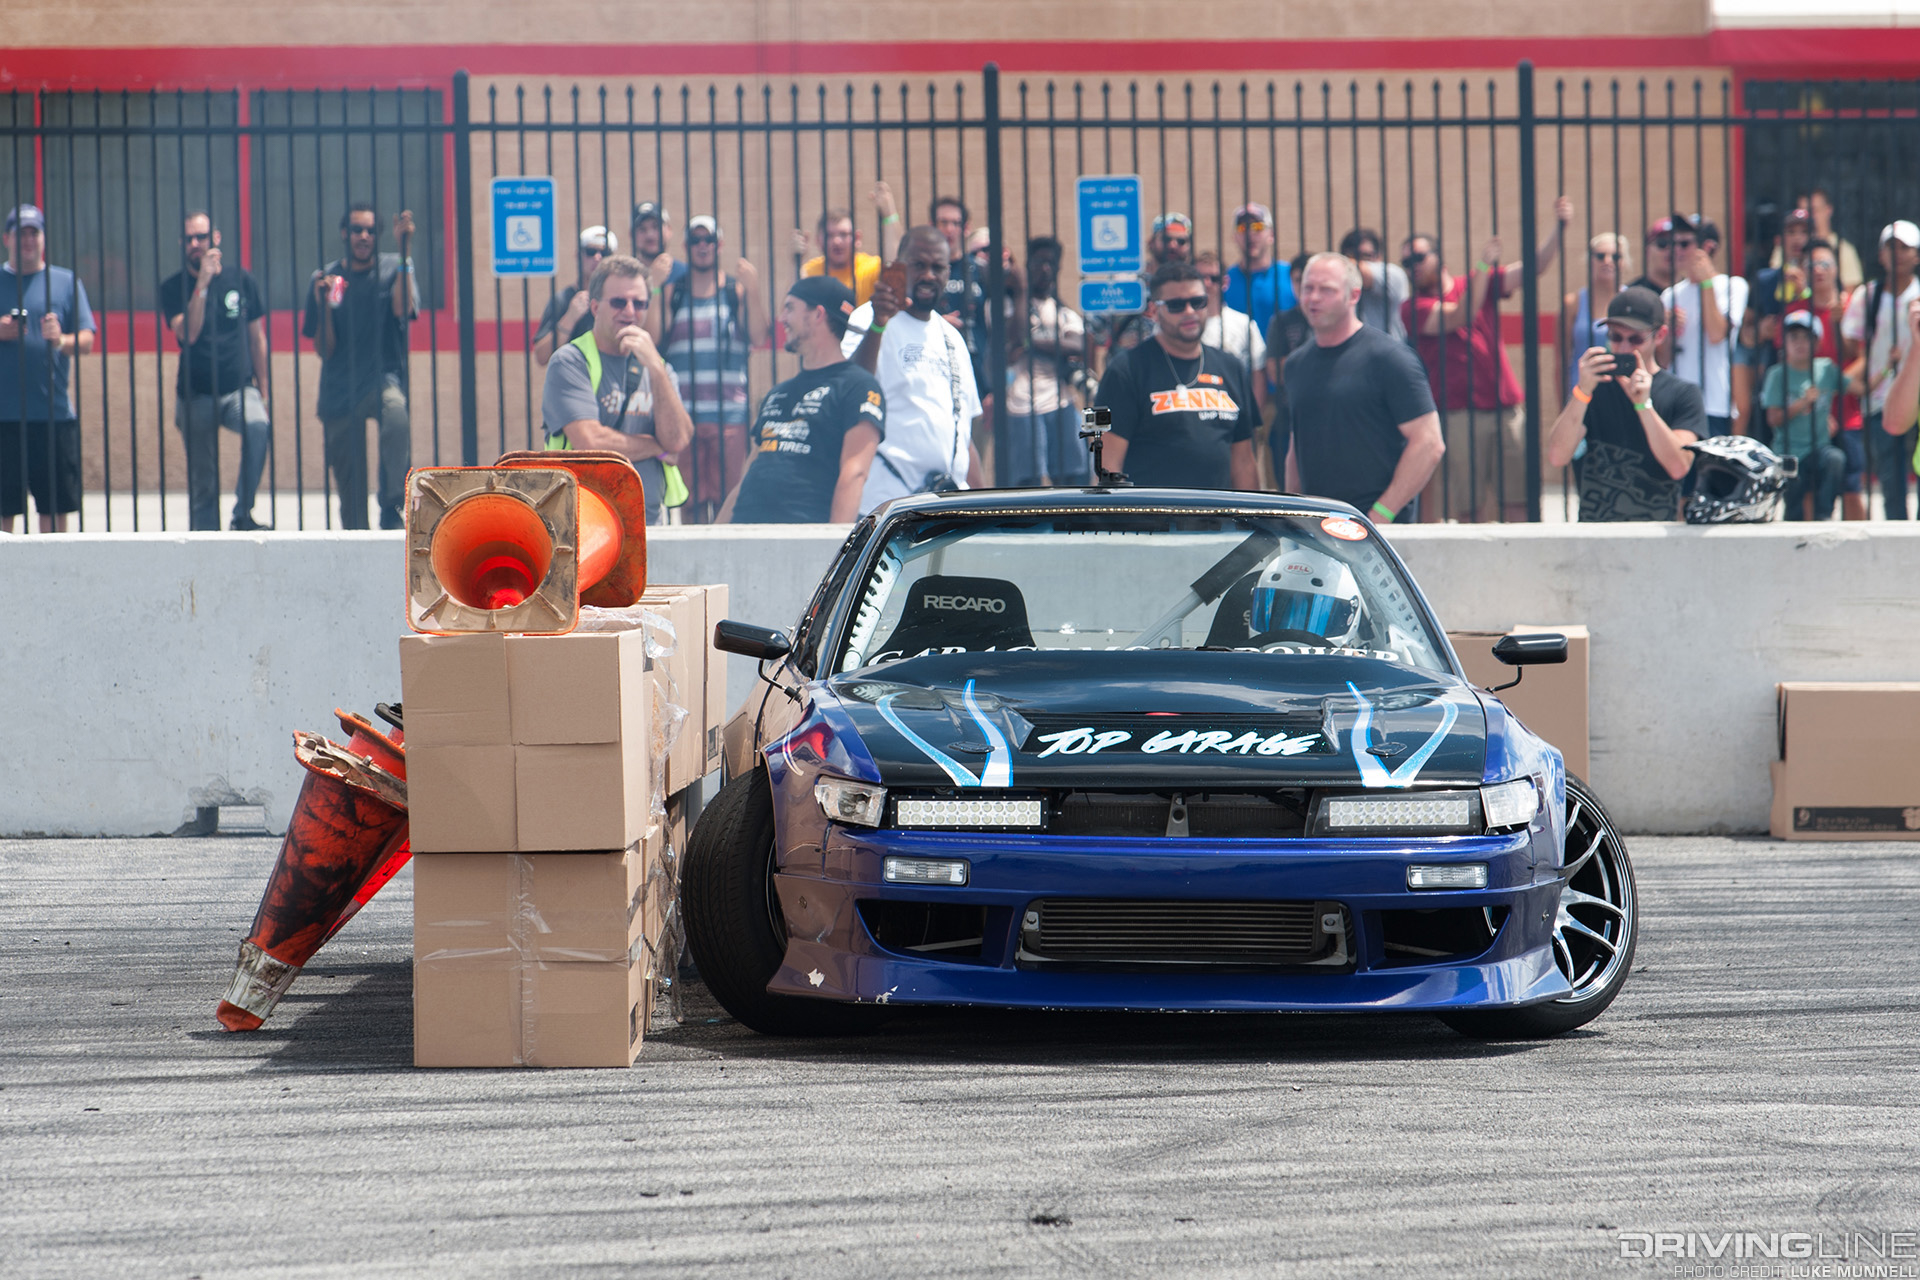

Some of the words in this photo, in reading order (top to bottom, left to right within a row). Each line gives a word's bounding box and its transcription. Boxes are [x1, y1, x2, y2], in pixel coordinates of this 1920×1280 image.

[778, 441, 812, 455] TIRES
[1287, 564, 1310, 573] BELL
[923, 594, 1007, 614] RECARO
[1037, 727, 1132, 759] TOP
[1141, 730, 1322, 756] GARAGE
